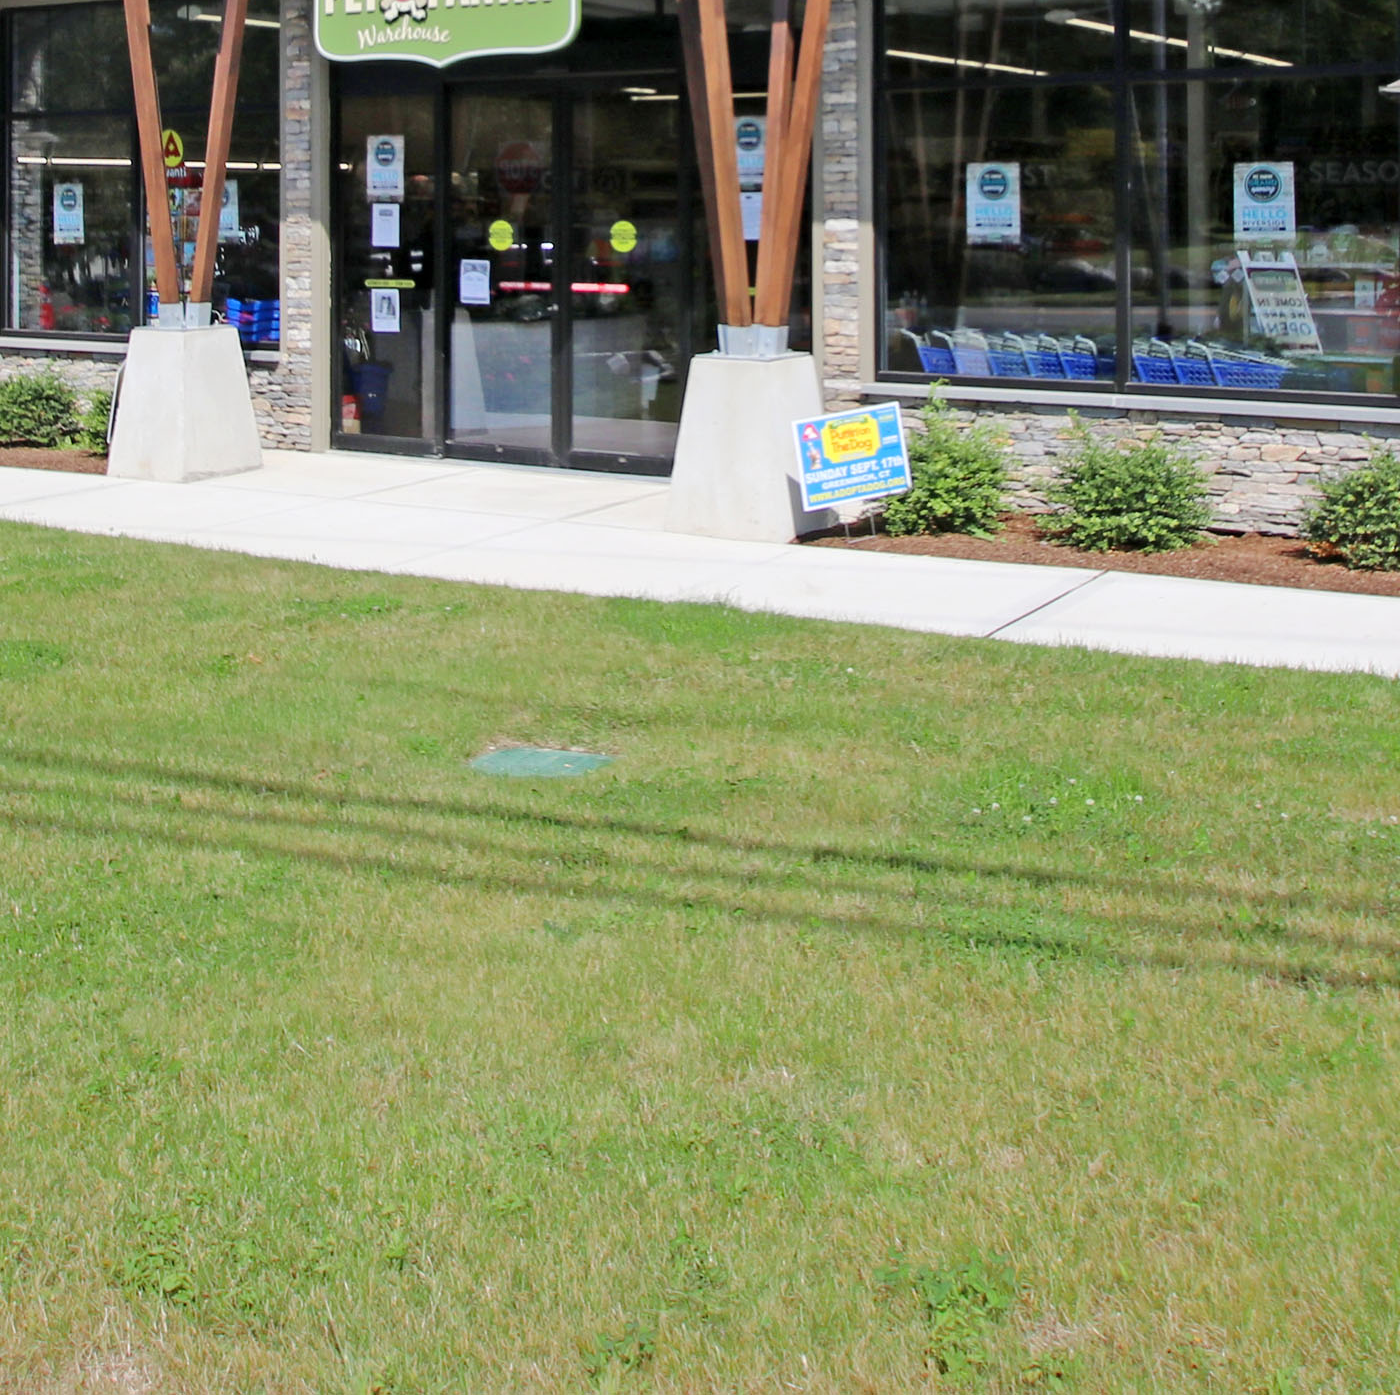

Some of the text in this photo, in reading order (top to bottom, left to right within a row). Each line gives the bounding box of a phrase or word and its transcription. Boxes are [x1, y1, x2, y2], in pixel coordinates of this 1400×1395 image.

[357, 15, 450, 49] Warehouse
[1242, 209, 1288, 220] HELLO
[805, 466, 848, 484] SUNDAY
[850, 460, 880, 474] SEPT.
